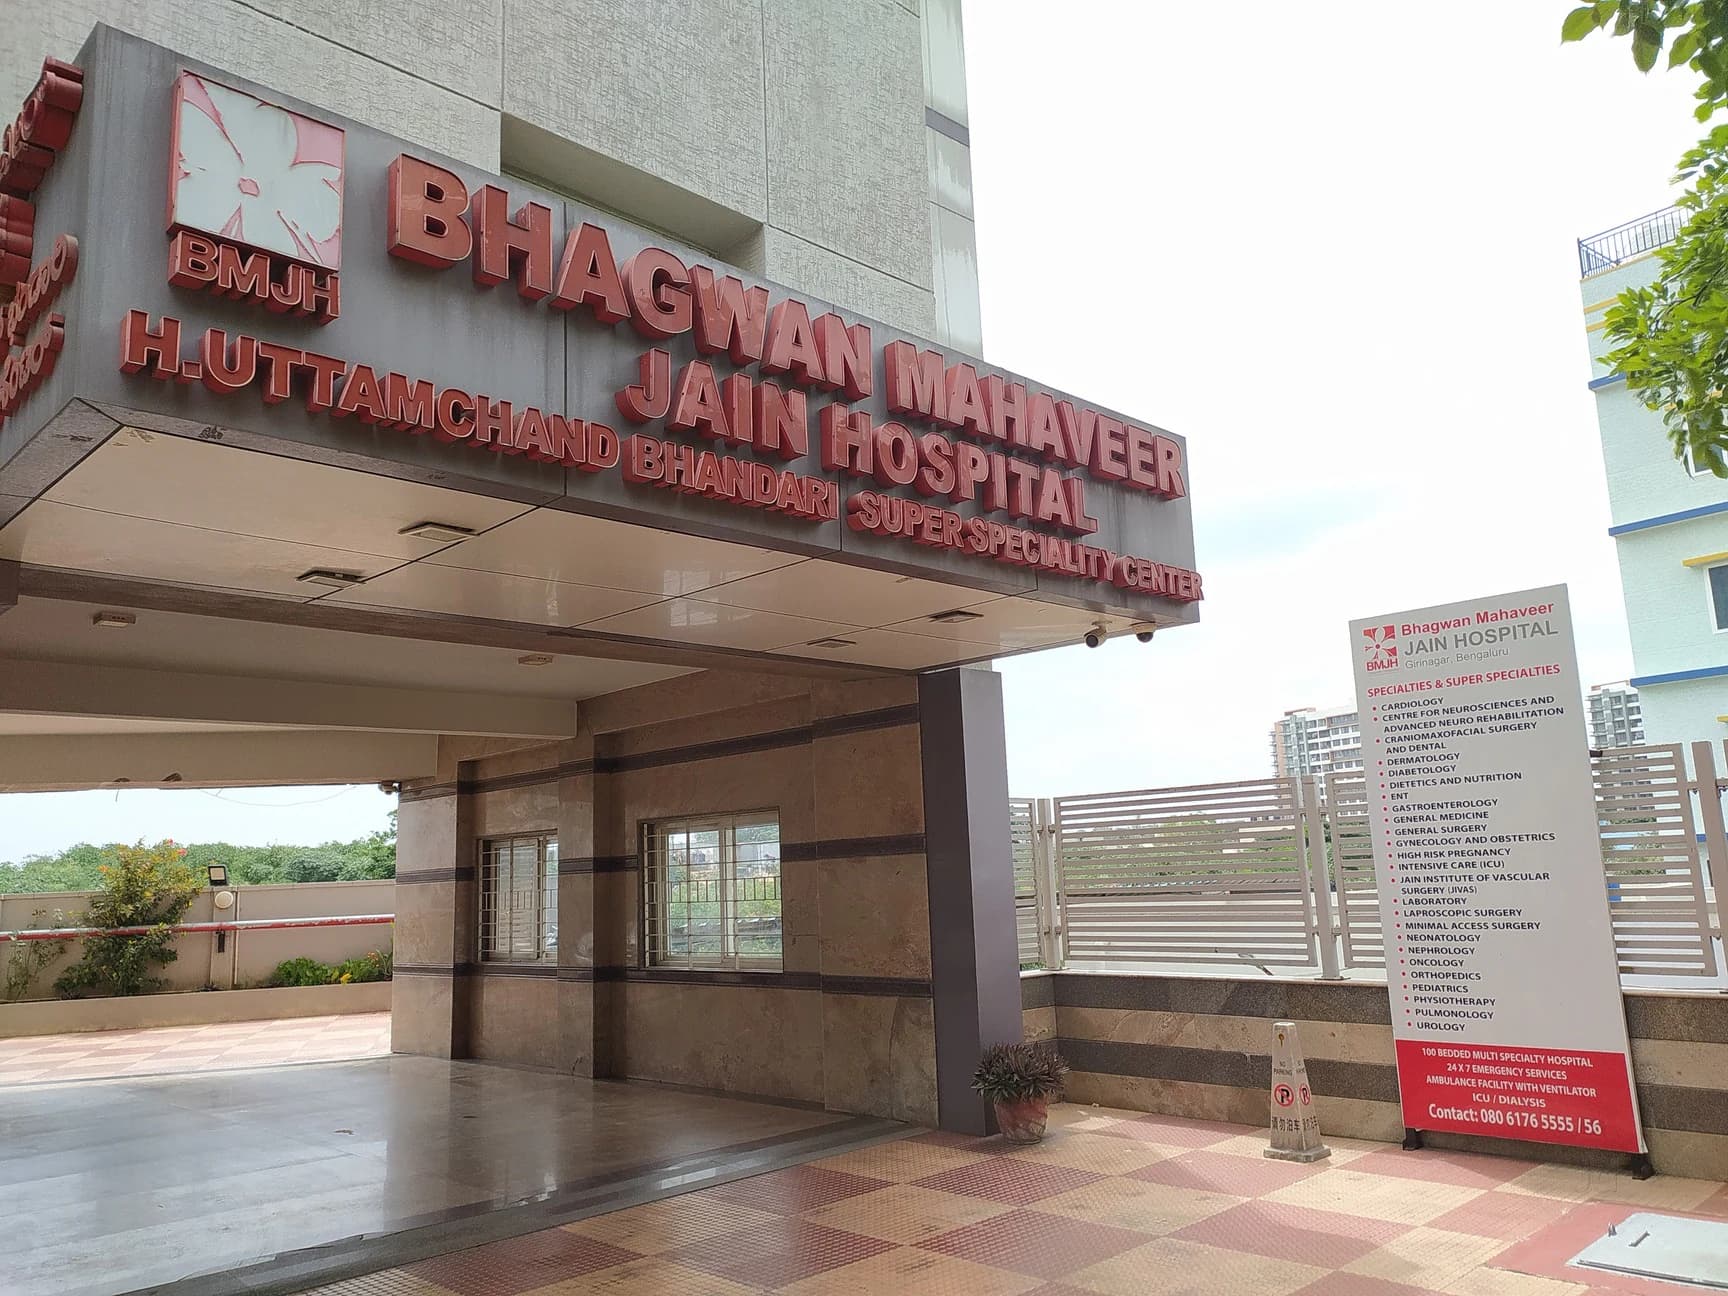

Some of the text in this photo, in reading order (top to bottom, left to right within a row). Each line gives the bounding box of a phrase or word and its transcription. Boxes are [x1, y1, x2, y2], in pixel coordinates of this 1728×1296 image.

[168, 231, 341, 325] BMJH
[388, 153, 1187, 500] BHAGWAN MAHAVEER
[615, 347, 1098, 535] JAIN HOSPITAL
[119, 309, 620, 473] H.UTTAMCHAND
[622, 433, 839, 522] BHANDARI
[847, 490, 965, 551] SUPER
[963, 518, 1117, 583] SPECIALITY
[1113, 554, 1205, 602] CENTER
[1401, 602, 1554, 636] Bhagwan Mahaveer
[1404, 620, 1559, 656] JAIN HOSPITAL
[1366, 658, 1399, 671] BMJH
[1405, 648, 1509, 669] Girinagar, Bengaluru
[1367, 664, 1561, 697] SPECIALTIES & SUPER SPECIALTIES
[1381, 697, 1444, 712] CARDIOLOGY
[1382, 695, 1555, 722] CENTRE FOR NEUROSCIENCES AND
[1383, 707, 1564, 734] ADVANCED NEURO REHABILITATION
[1384, 722, 1537, 744] CRANIOMAXOFACIAL SURGERY
[1409, 742, 1446, 752] DENTAL
[1387, 753, 1460, 766] DERMATOLOGY
[1388, 765, 1457, 777] DIABETOLOGY
[1390, 772, 1522, 790] DIETETICS AND NUTRITION
[1392, 799, 1498, 813] GASTROENTEROLOGY
[1393, 812, 1489, 824] GENERAL MEDICINE
[1395, 825, 1487, 836] GENERAL SURGERY
[1396, 833, 1556, 847] GYNECOLOGY AND OBSTETRICS
[1397, 852, 1421, 860] HIGH
[1448, 848, 1511, 858] PREGNANCY
[1398, 862, 1448, 871] INTENSIVE
[1479, 860, 1505, 870] (ICU)
[1400, 875, 1421, 884] JAIN
[1423, 875, 1474, 883] INSTITUTE
[1492, 873, 1550, 881] VASCULAR
[1401, 886, 1477, 895] SURGERY (JIVAS)
[1404, 909, 1522, 917] LAPROSCOPIC SURGERY
[1406, 922, 1541, 930] MINIMAL ACCESS SURGERY
[1407, 934, 1481, 942] NEONATOLOGY
[1408, 946, 1475, 955] NEPHROLOGY
[1409, 958, 1464, 967] ONCOLOGY
[1411, 971, 1481, 981] ORTHOPEDICS
[1412, 984, 1468, 993] PEDIATRICS
[1414, 996, 1496, 1006] PHYSIOTHERAPY
[1415, 1008, 1494, 1020] PULMONOLOGY
[1417, 1021, 1465, 1031] UROLOGY
[1422, 1047, 1593, 1067] 100 BEDDED MULTI SPECIALTY HOSPITAL
[1447, 1063, 1567, 1080] 24 X 7 EMERGENCY SERVICES
[1426, 1075, 1597, 1098] AMBULANCE FACILITY WITH VENTILATOR
[1472, 1093, 1546, 1108] ICU / DIALYSIS
[1429, 1104, 1602, 1135] Contact: 080 6176 5555 / 56
